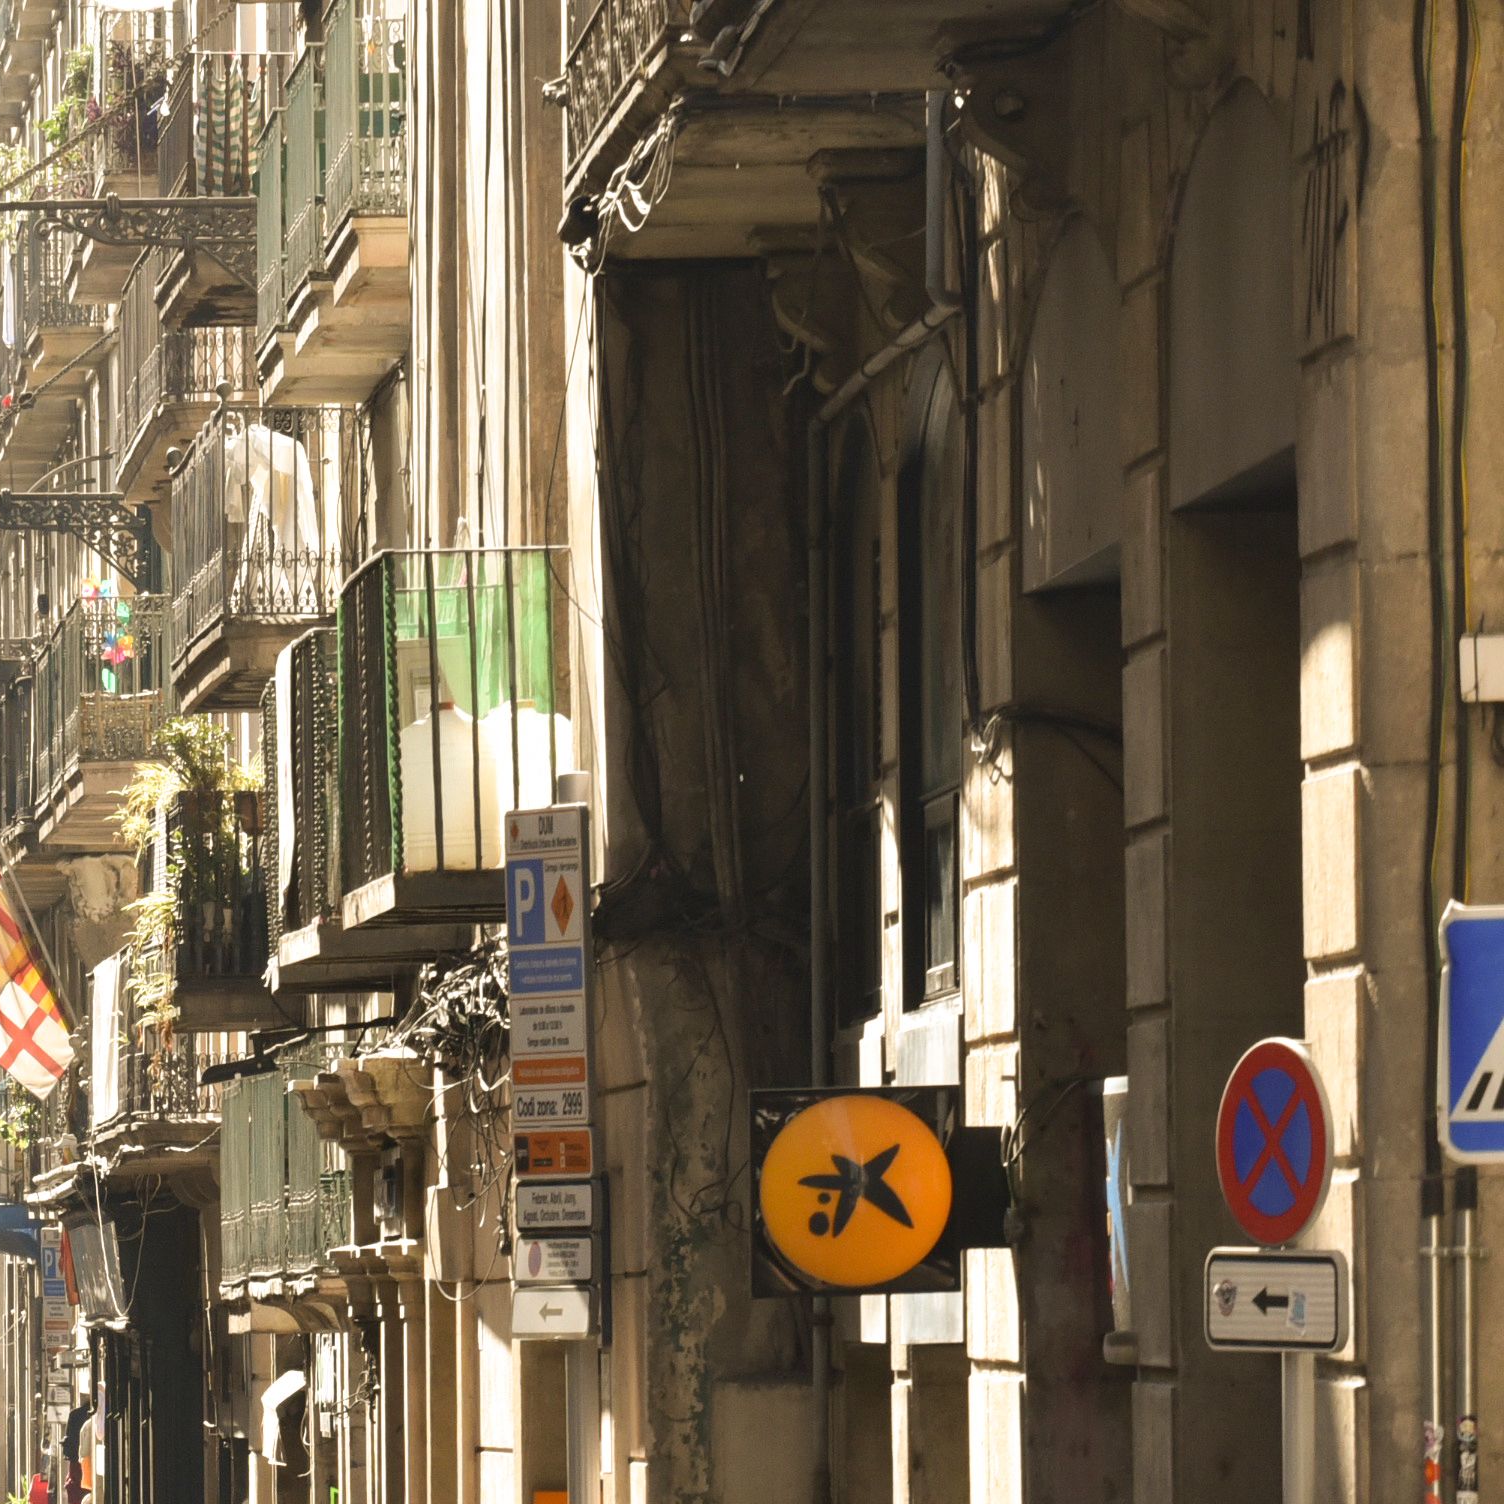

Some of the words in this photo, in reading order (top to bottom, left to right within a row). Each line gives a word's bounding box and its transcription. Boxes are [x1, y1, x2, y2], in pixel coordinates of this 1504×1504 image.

[514, 868, 535, 937] P
[517, 1096, 535, 1117] Codi
[537, 1101, 558, 1116] zona:
[44, 1249, 53, 1276] P
